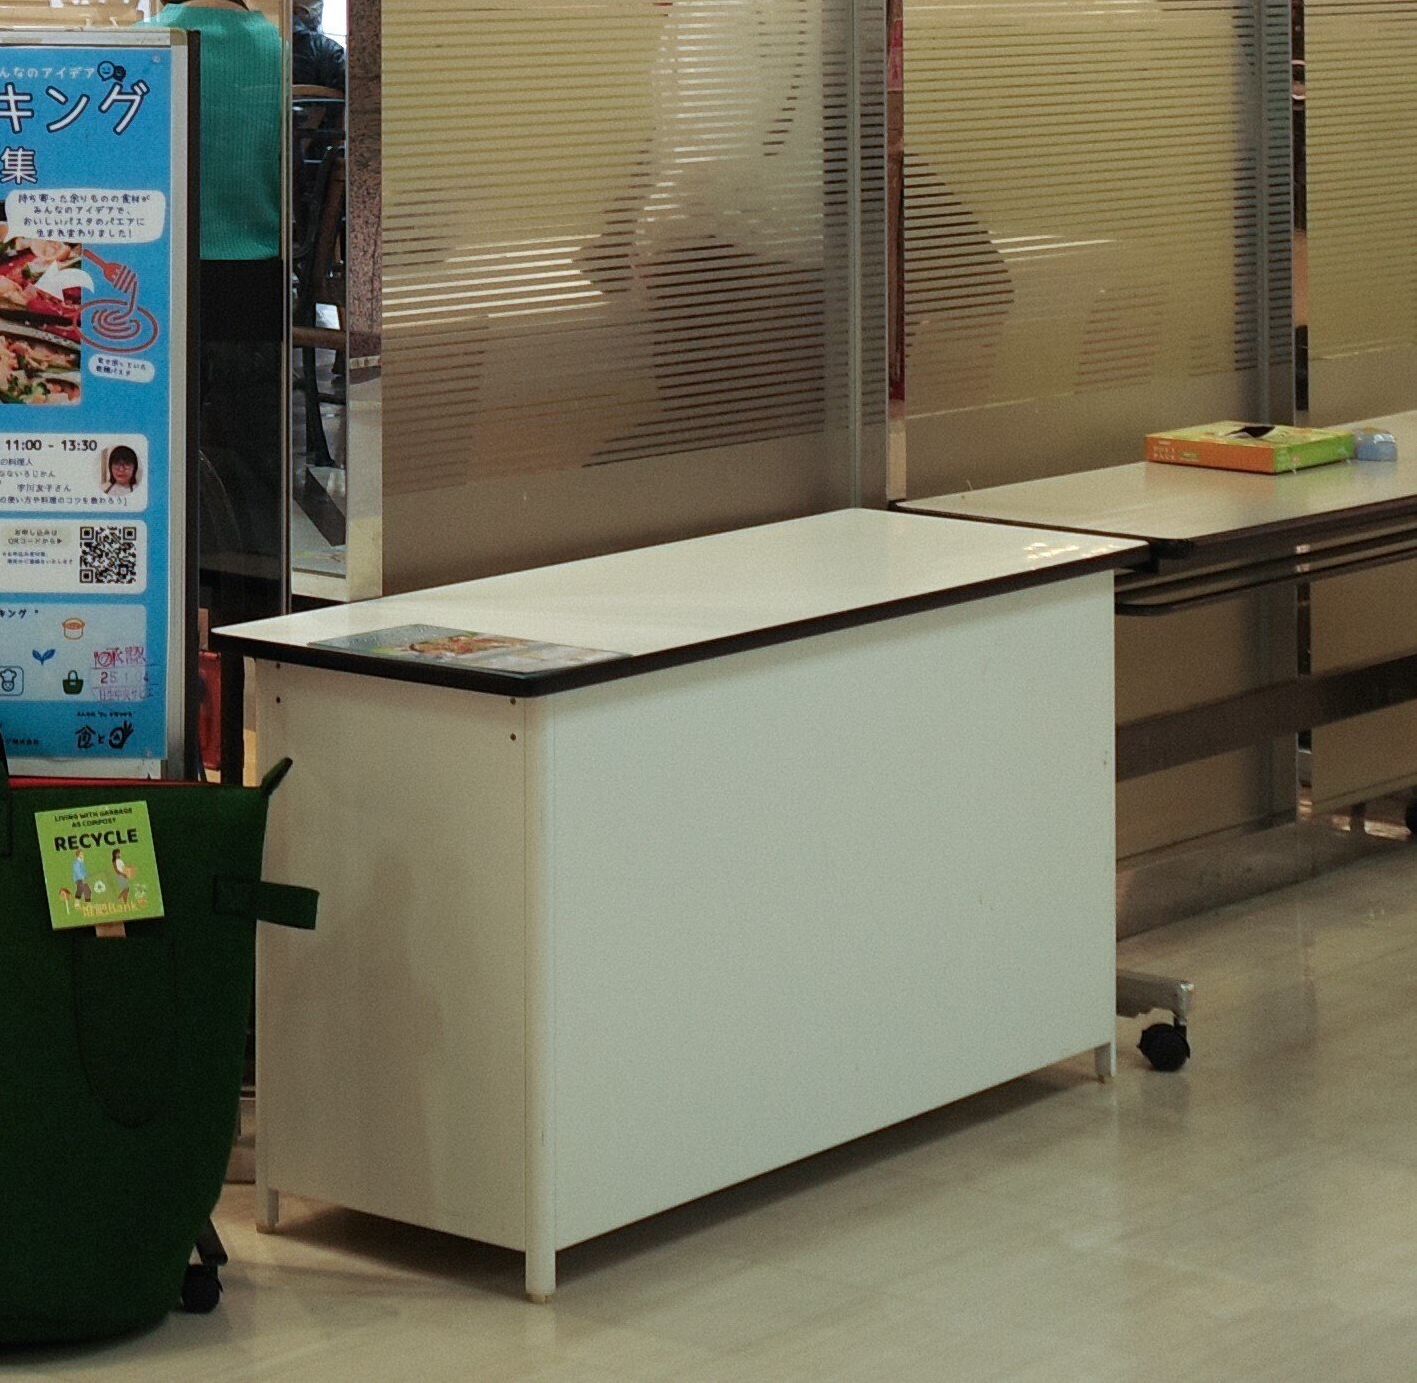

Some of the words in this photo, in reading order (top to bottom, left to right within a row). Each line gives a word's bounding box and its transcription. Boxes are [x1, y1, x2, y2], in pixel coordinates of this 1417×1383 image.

[5, 439, 42, 451] 11:00
[61, 439, 97, 451] 13:30
[54, 828, 139, 852] RECYCLE
